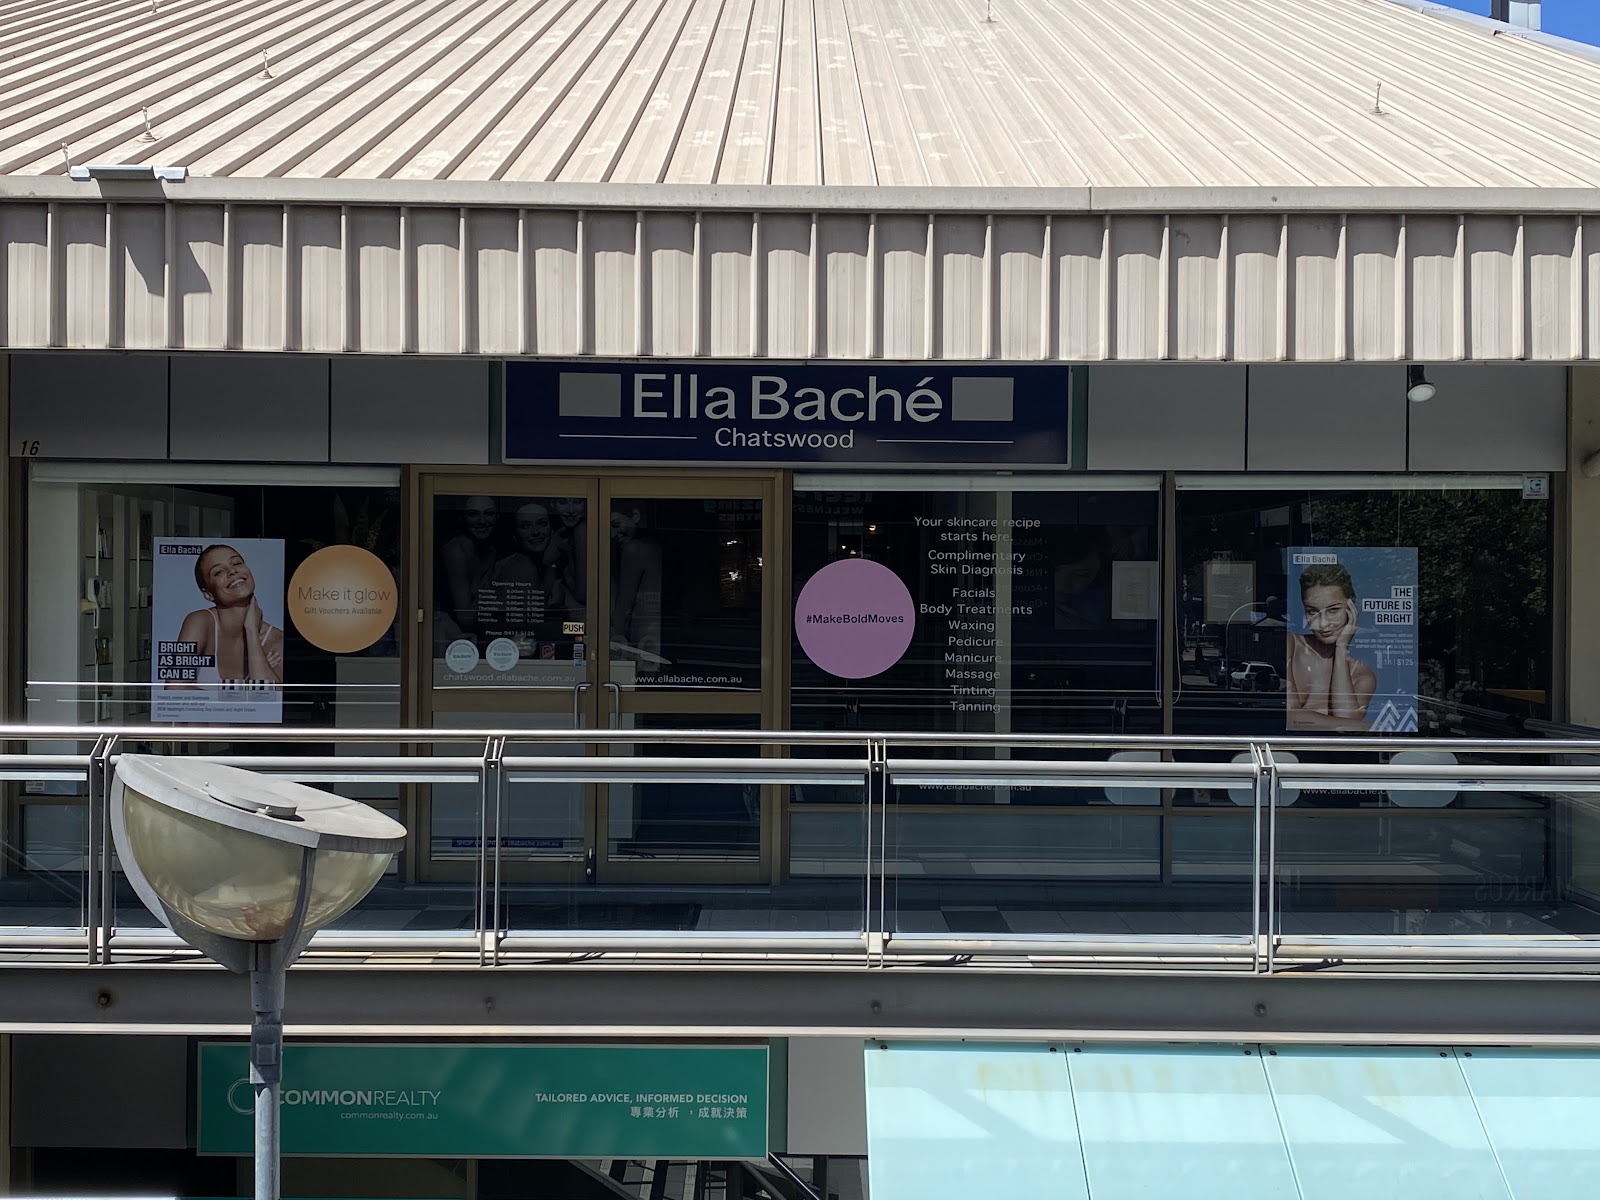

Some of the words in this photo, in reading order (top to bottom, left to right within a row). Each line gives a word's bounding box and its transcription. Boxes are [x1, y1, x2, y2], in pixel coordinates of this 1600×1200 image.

[633, 373, 737, 420] Ella
[751, 375, 944, 424] Baché
[714, 427, 855, 449] Chatswood
[21, 440, 40, 456] 16
[914, 516, 944, 527] Your
[946, 516, 998, 527] skincare
[1002, 517, 1042, 530] recipe
[940, 532, 978, 542] starts
[982, 531, 1014, 542] here.
[160, 546, 177, 554] Ella
[177, 545, 202, 554] Baché
[928, 550, 1027, 563] Complimentary
[1294, 555, 1311, 563] Ella
[1312, 555, 1336, 564] Baché
[930, 563, 957, 575] Skin
[961, 564, 1024, 577] Diagnosis
[298, 586, 340, 601] Make
[343, 587, 351, 601] it
[355, 587, 391, 604] glow
[952, 587, 996, 599] Facials
[1393, 587, 1412, 597] THE
[919, 604, 953, 616] Body
[957, 604, 1033, 615] Treatments
[1364, 600, 1400, 610] FUTURE
[1402, 600, 1412, 610] IS
[304, 607, 317, 615] Gift
[318, 607, 350, 615] Vouchers
[351, 607, 382, 615] Available
[806, 614, 904, 624] #MakeBoldMoves
[1376, 613, 1412, 623] BRIGHT
[563, 624, 584, 632] PUSH
[948, 620, 995, 633] Waxing
[948, 636, 1003, 647] Pedicure
[160, 642, 196, 653] BRIGHT
[159, 656, 174, 666] AS
[175, 656, 211, 666] BRIGHT
[944, 652, 1002, 663] Manicure
[159, 669, 180, 679] CAN
[182, 669, 195, 679] BE
[443, 673, 576, 683] chatswood.ellabache.com.au
[632, 674, 743, 683] www.ellabache.com.au
[945, 669, 1001, 681] Massage
[950, 685, 996, 697] Tinting
[950, 701, 1001, 714] Tanning
[535, 1093, 587, 1103] TAILORED
[589, 1093, 633, 1104] ADVICE,
[636, 1093, 693, 1103] INFORMED
[697, 1094, 748, 1104] DECISION
[340, 1111, 439, 1122] commonrealty.com.au
